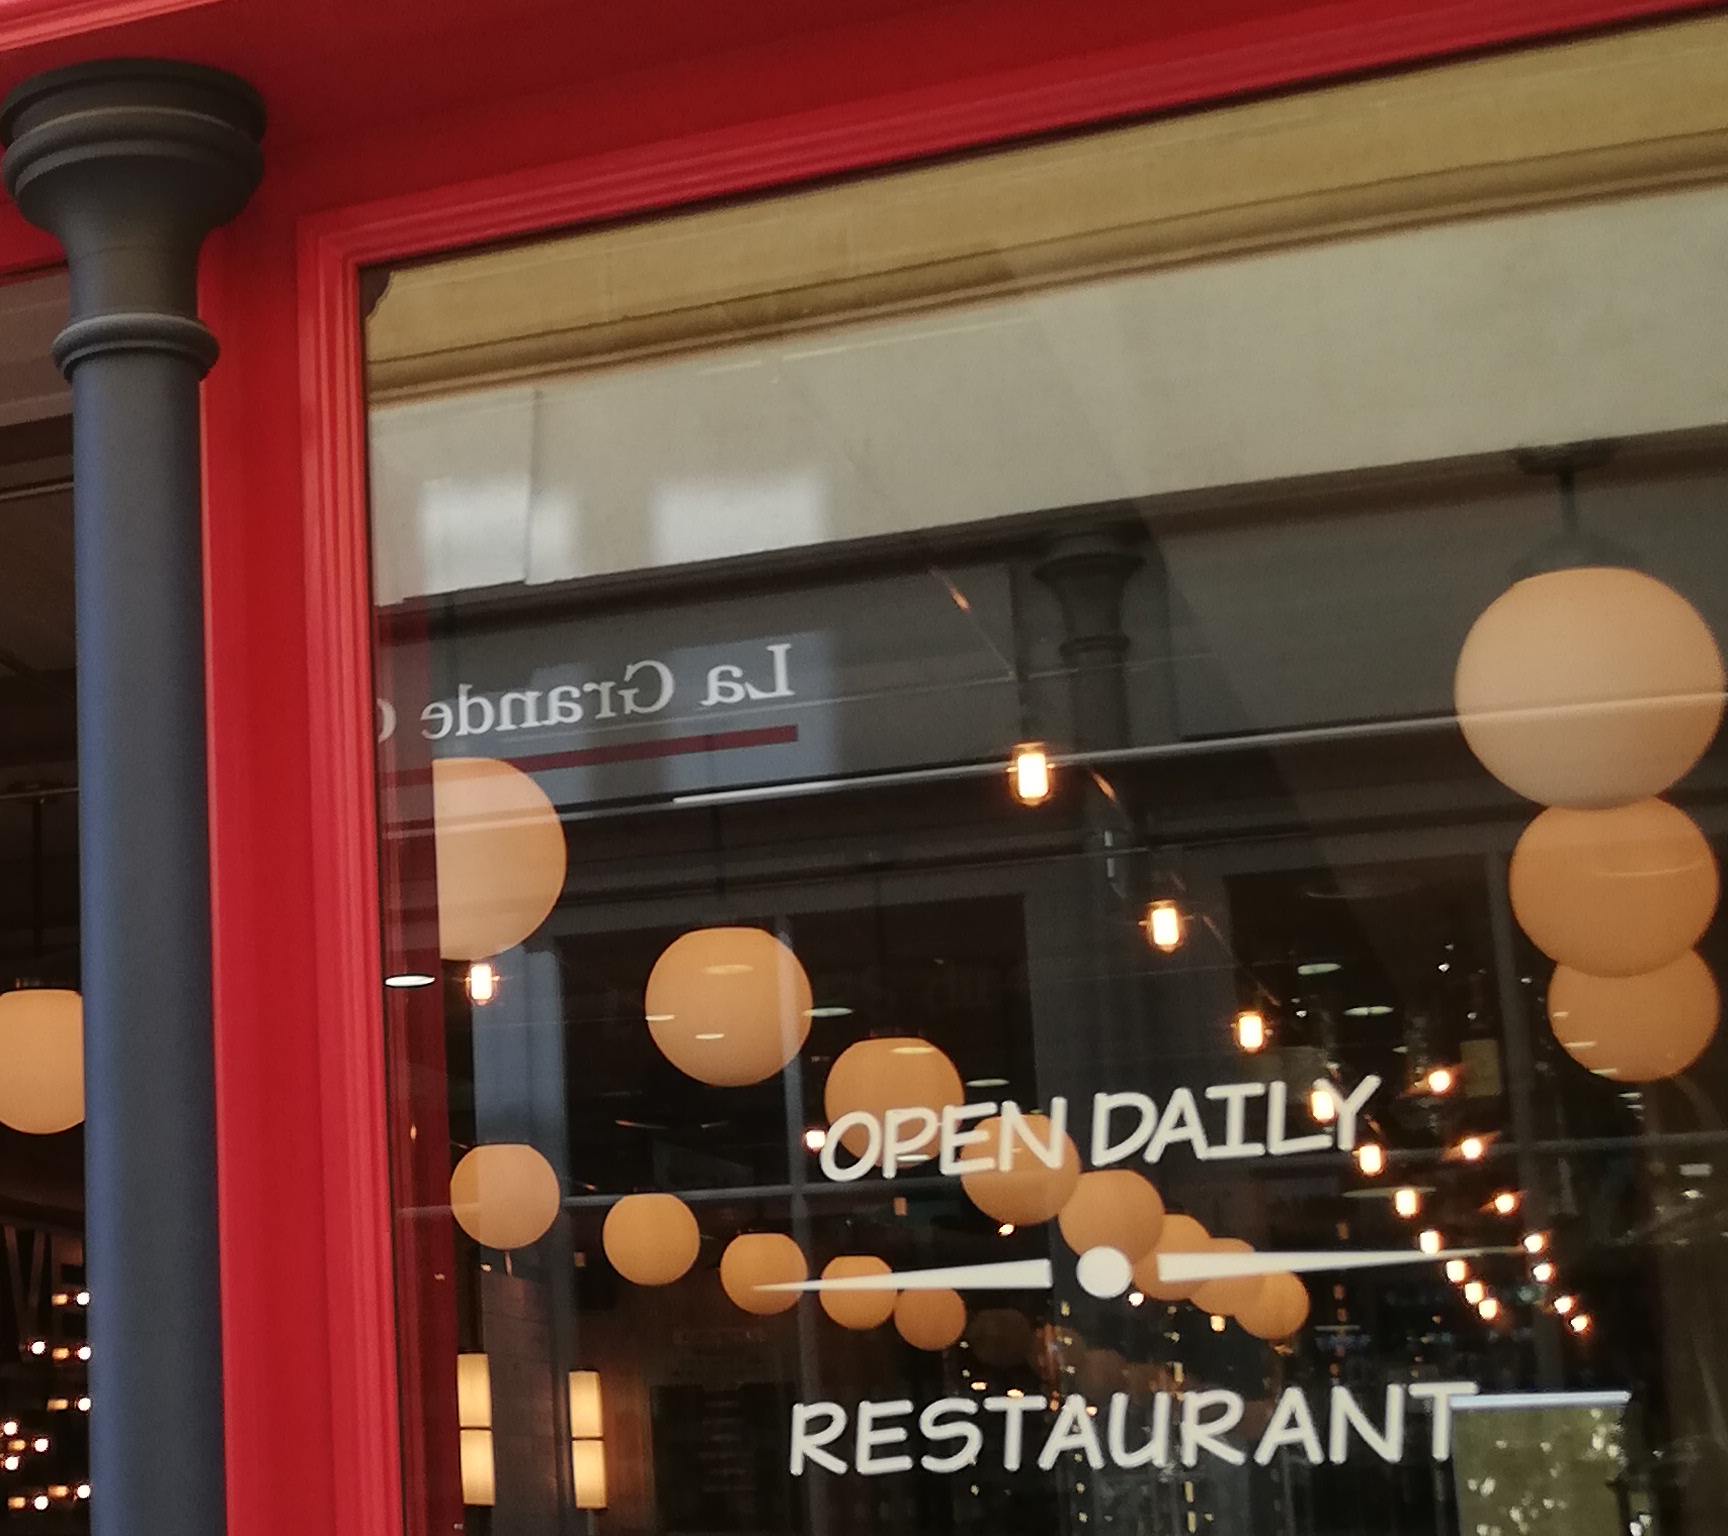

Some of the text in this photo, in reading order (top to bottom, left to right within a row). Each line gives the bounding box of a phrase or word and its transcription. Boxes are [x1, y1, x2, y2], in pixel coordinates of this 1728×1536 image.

[819, 1075, 1382, 1182] OPEN DAILY
[790, 1382, 1477, 1475] RESTAURANT
